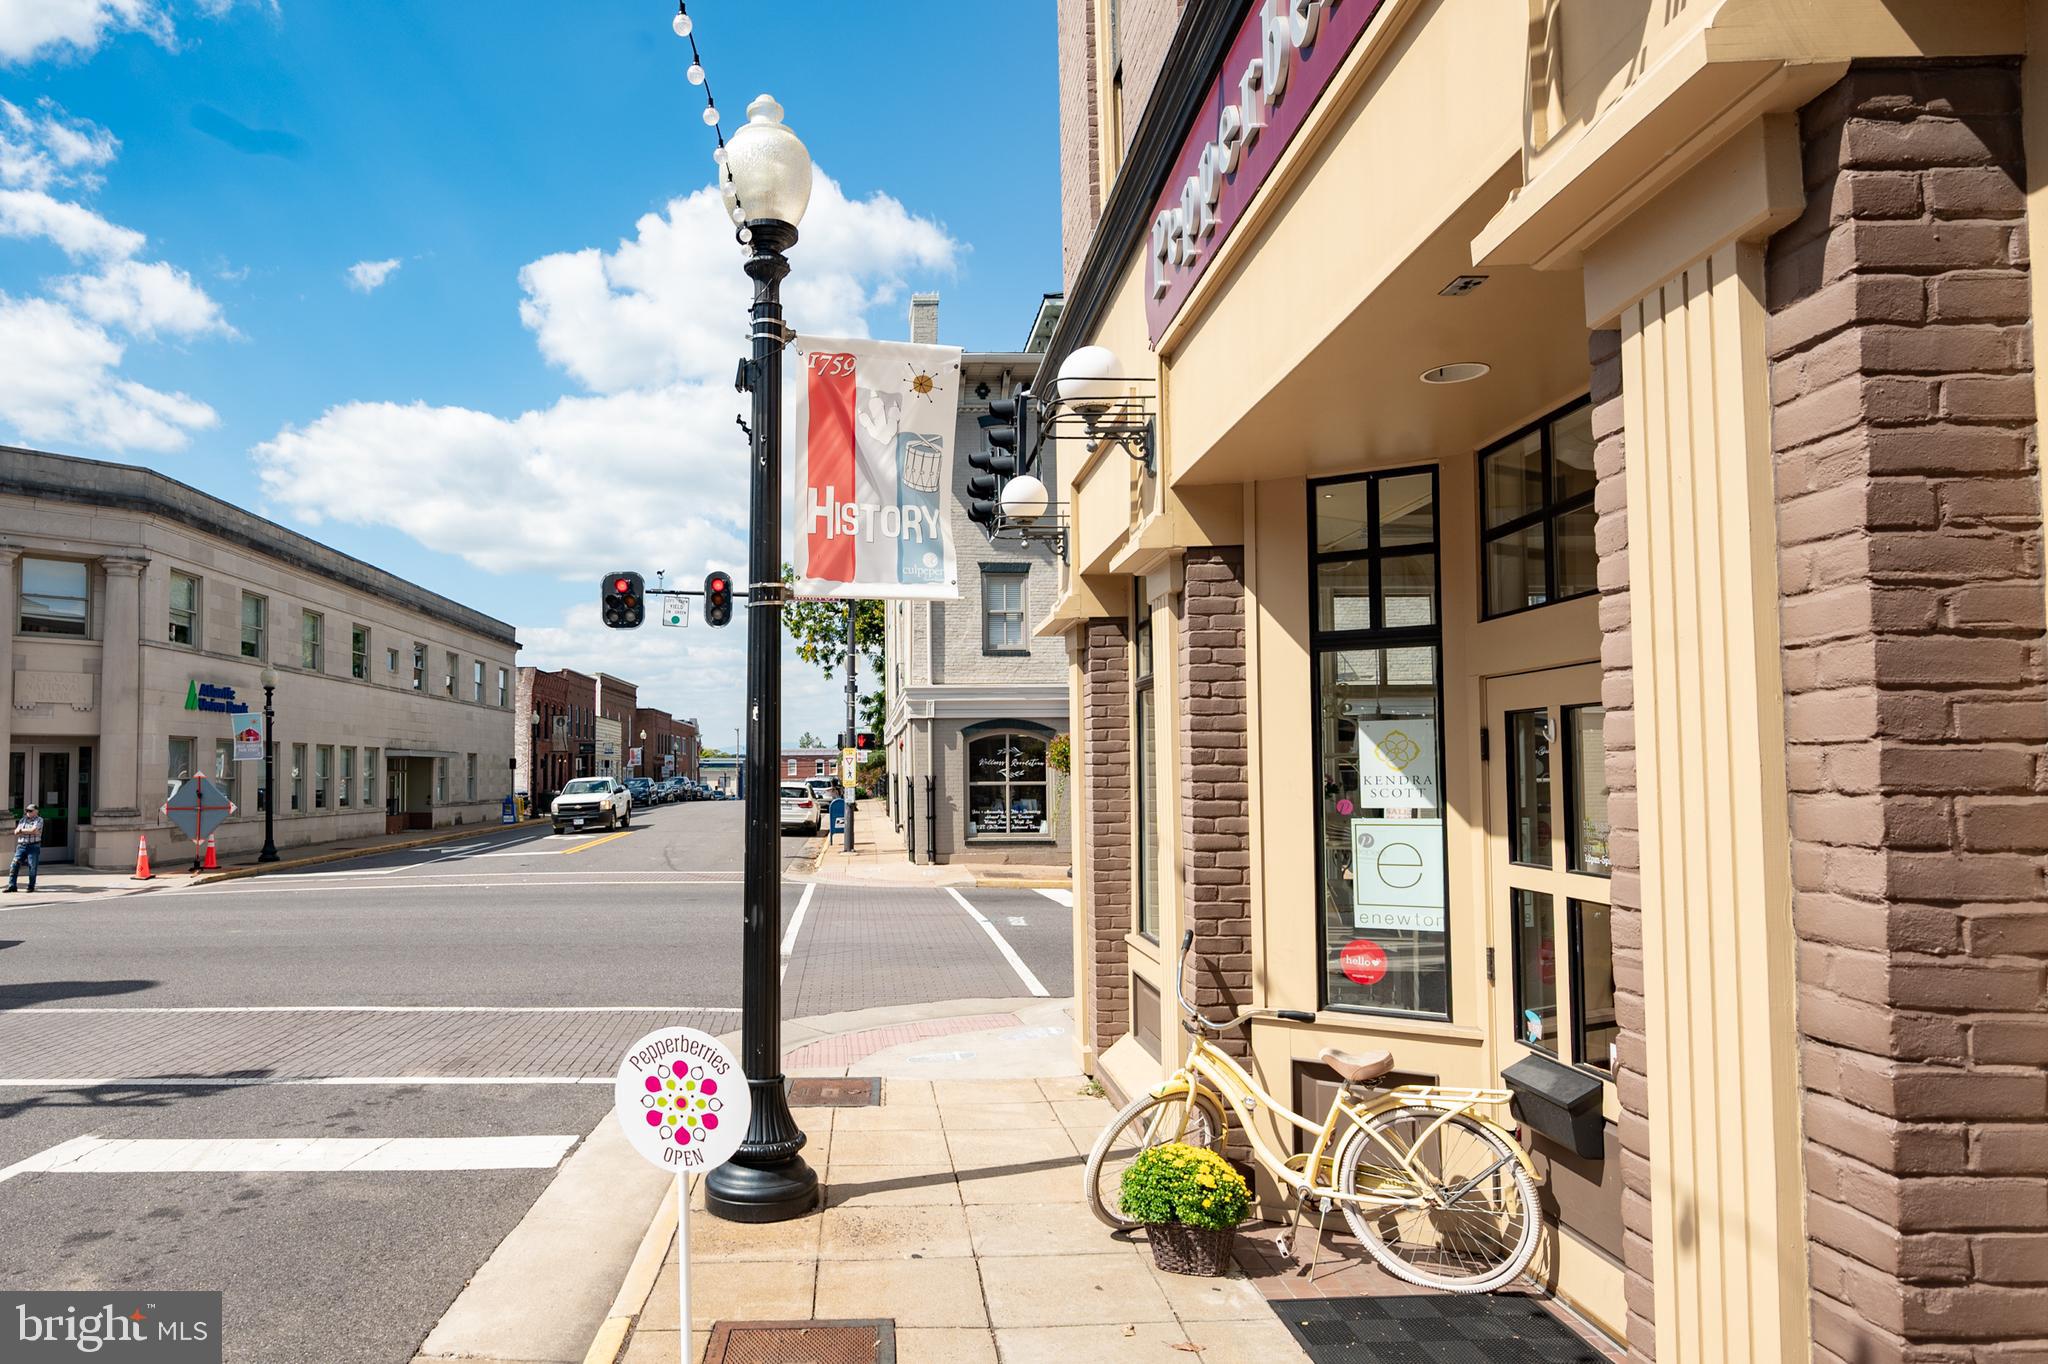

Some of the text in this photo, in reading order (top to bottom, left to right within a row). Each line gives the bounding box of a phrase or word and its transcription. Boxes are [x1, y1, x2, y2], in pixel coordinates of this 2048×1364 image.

[808, 354, 857, 378] 1759
[807, 485, 941, 544] HISTORY
[903, 562, 944, 578] culpeper
[199, 683, 235, 700] Atlantic
[198, 698, 249, 713] Union Bank
[1363, 775, 1432, 785] KENDRA
[1370, 788, 1426, 798] SCOTT
[1345, 954, 1371, 966] hello
[629, 1034, 731, 1075] Pepperberries
[663, 1146, 705, 1167] OPEN
